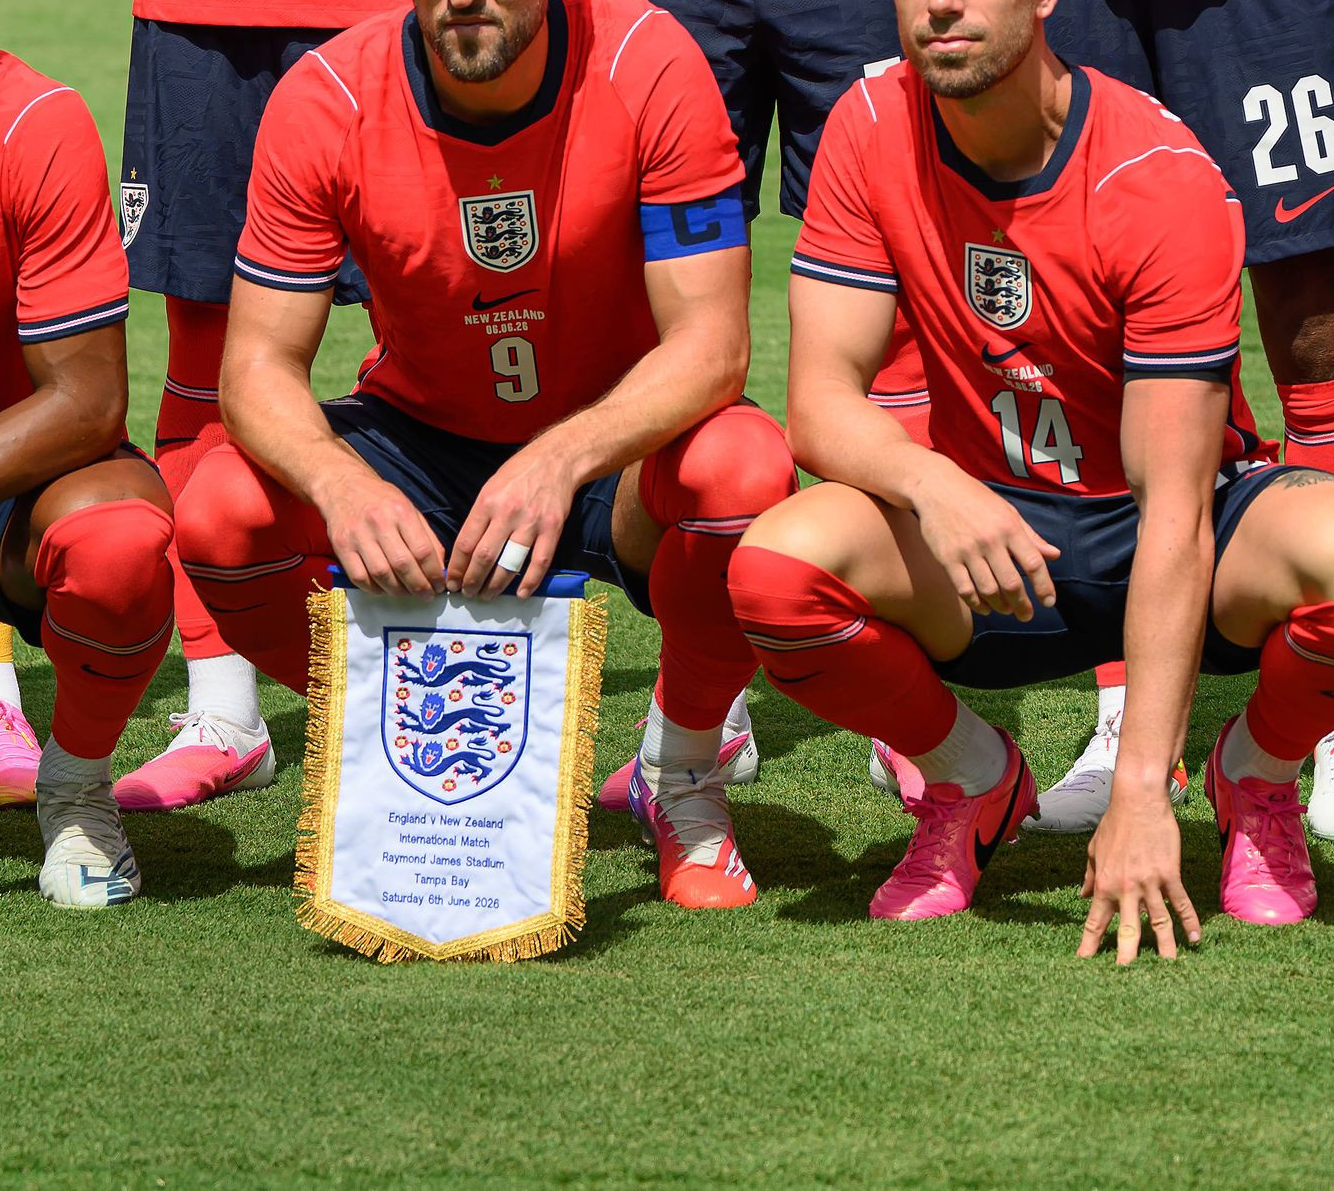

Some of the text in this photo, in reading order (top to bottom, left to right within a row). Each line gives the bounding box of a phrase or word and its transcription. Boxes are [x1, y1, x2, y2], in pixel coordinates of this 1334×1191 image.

[670, 198, 722, 247] C
[464, 309, 546, 326] NEW ZEALAND
[485, 321, 529, 336] 06.06.26
[489, 335, 541, 404] 9
[1004, 363, 1054, 380] ZEALAND
[990, 389, 1085, 485] 14
[388, 812, 504, 829] England v New Zealand
[399, 833, 490, 849] International Match
[382, 851, 505, 870] Raymond James Stadium
[414, 872, 470, 889] Tampa Bay
[382, 891, 500, 909] Saturday 6th June 2026
